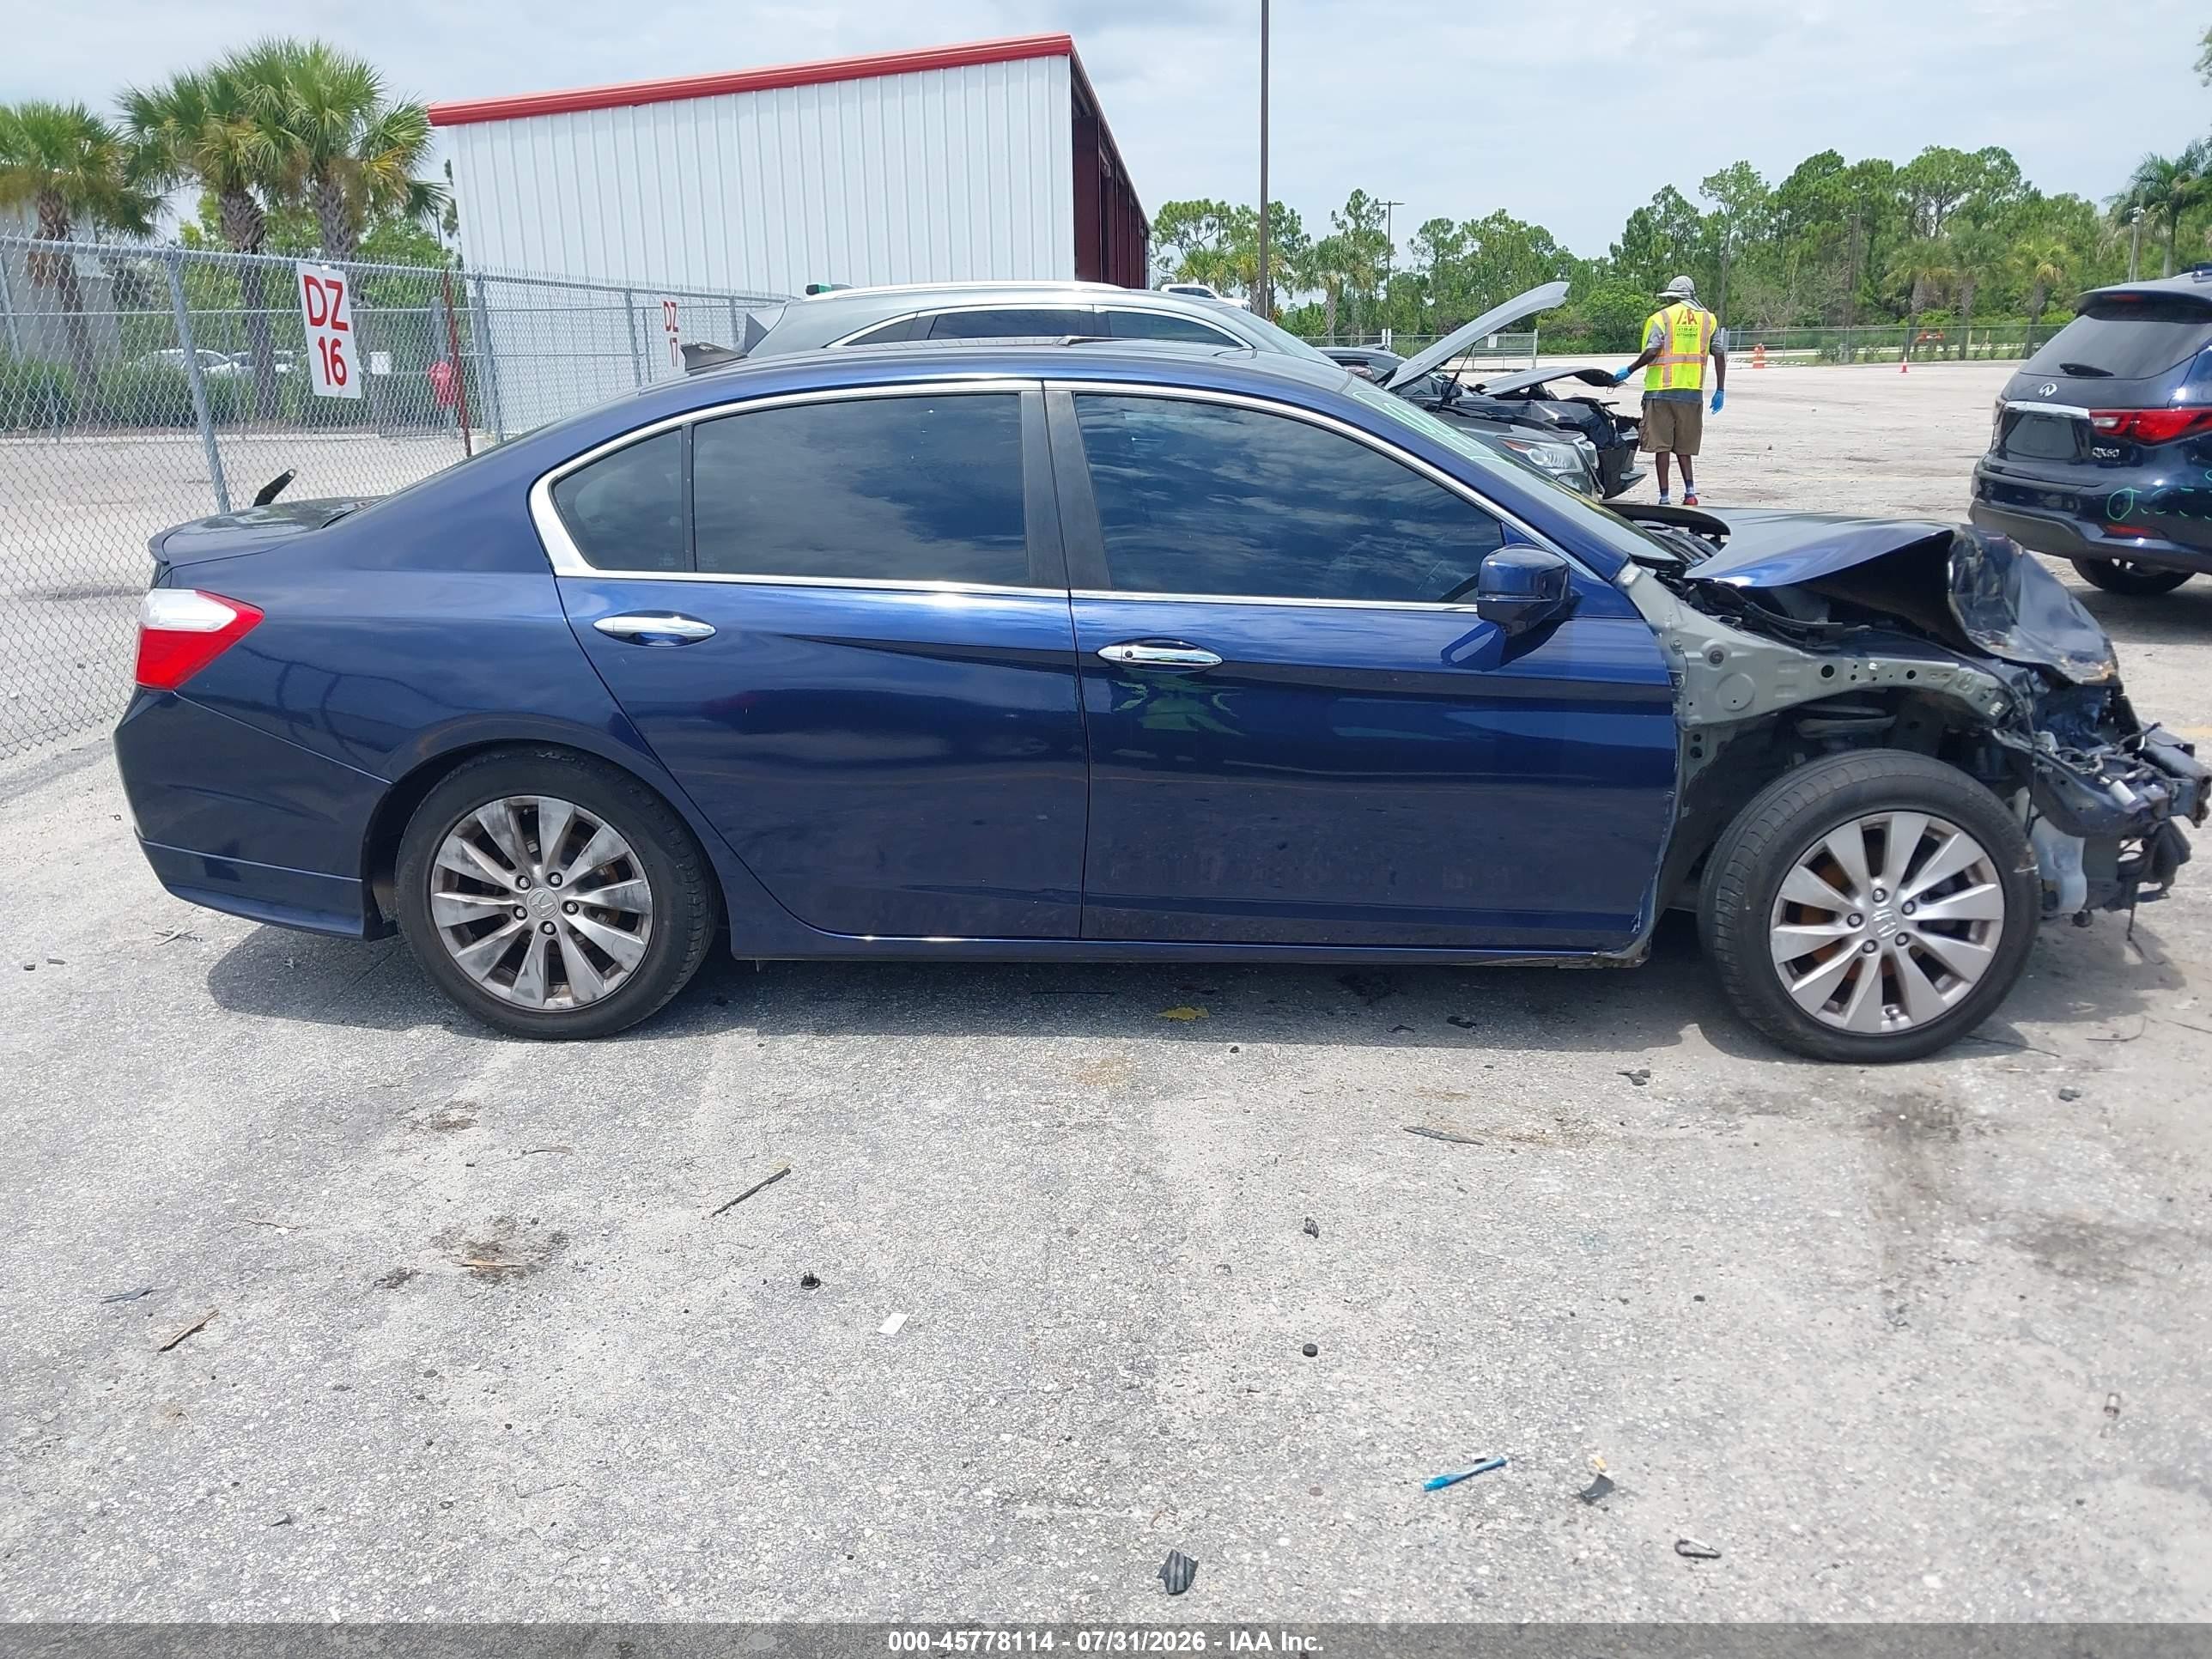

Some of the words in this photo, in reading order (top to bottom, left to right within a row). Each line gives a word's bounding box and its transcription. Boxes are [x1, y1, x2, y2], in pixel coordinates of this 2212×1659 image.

[304, 275, 349, 331] DZ
[664, 301, 679, 332] DZ
[318, 336, 347, 386] 16
[669, 337, 678, 368] 17
